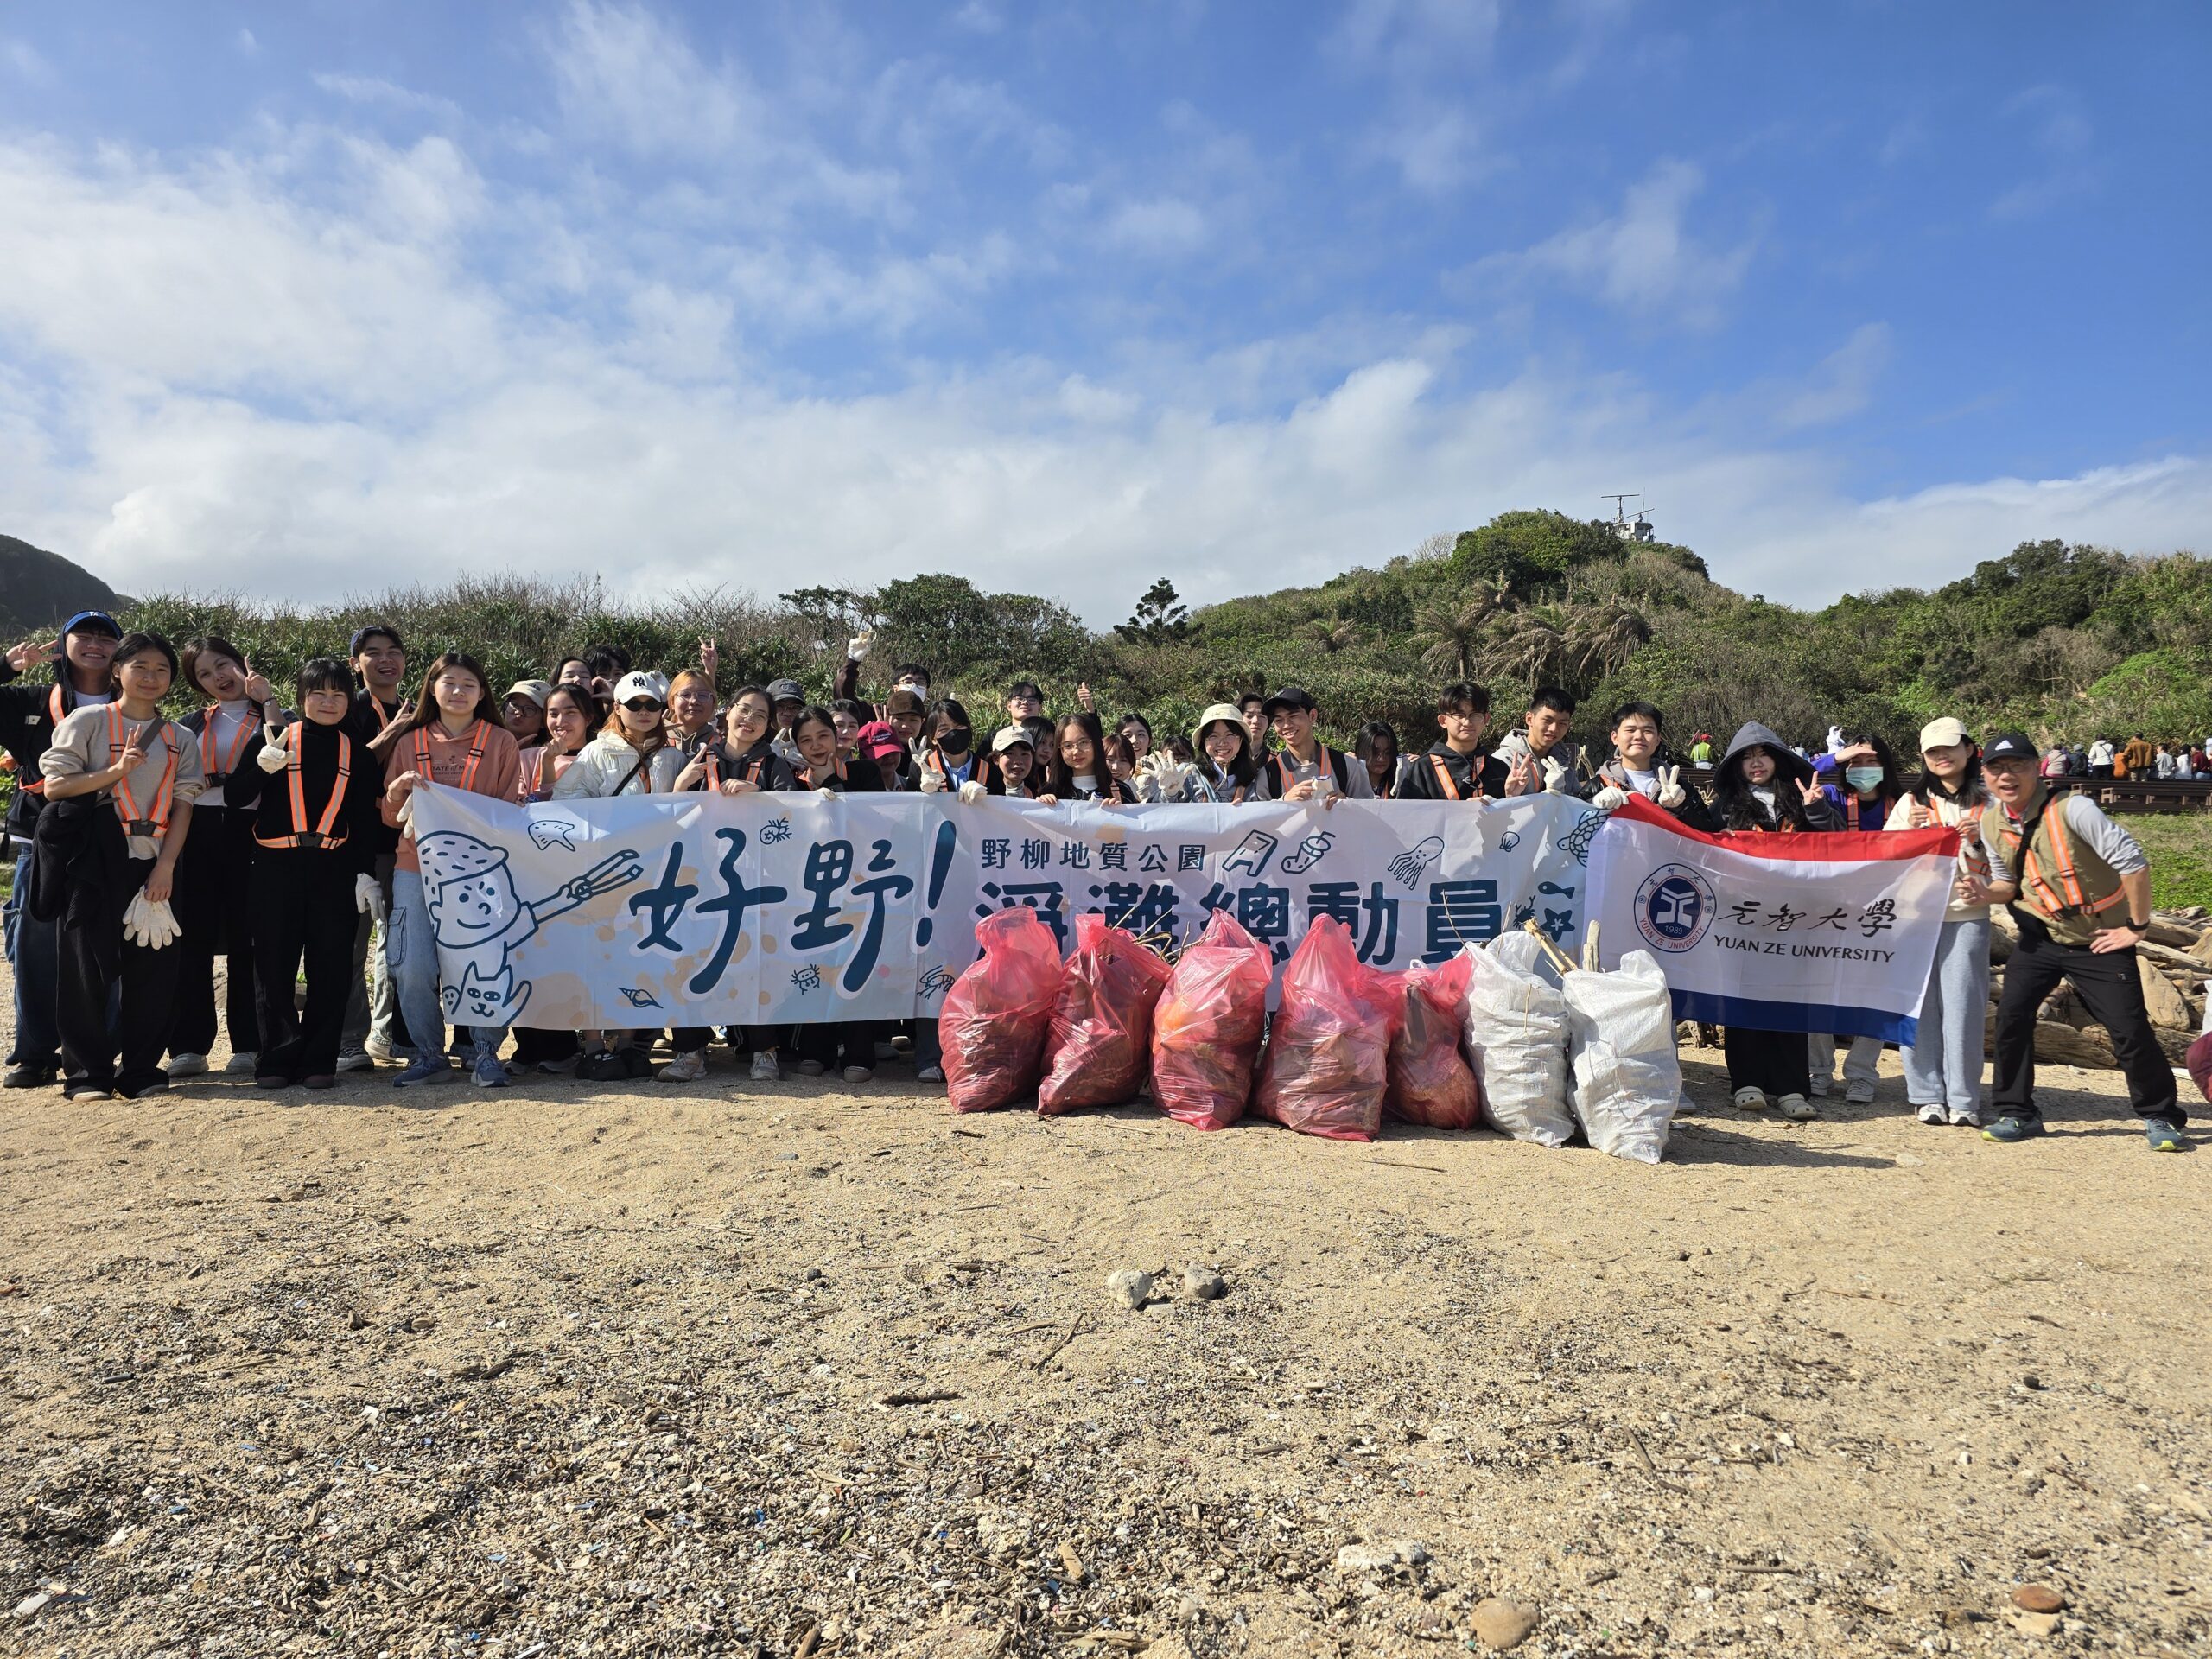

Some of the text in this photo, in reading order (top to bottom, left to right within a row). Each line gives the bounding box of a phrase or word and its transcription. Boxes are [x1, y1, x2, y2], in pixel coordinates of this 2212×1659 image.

[982, 838, 1206, 873] 野柳地質公園
[629, 820, 957, 995] 好野!
[1718, 899, 1897, 938] 元智大學
[1639, 917, 1704, 949] YUAN ZE UNIVERSITY
[1664, 925, 1683, 935] 1989
[1714, 935, 1896, 963] YUAN ZE UNIVERSITY
